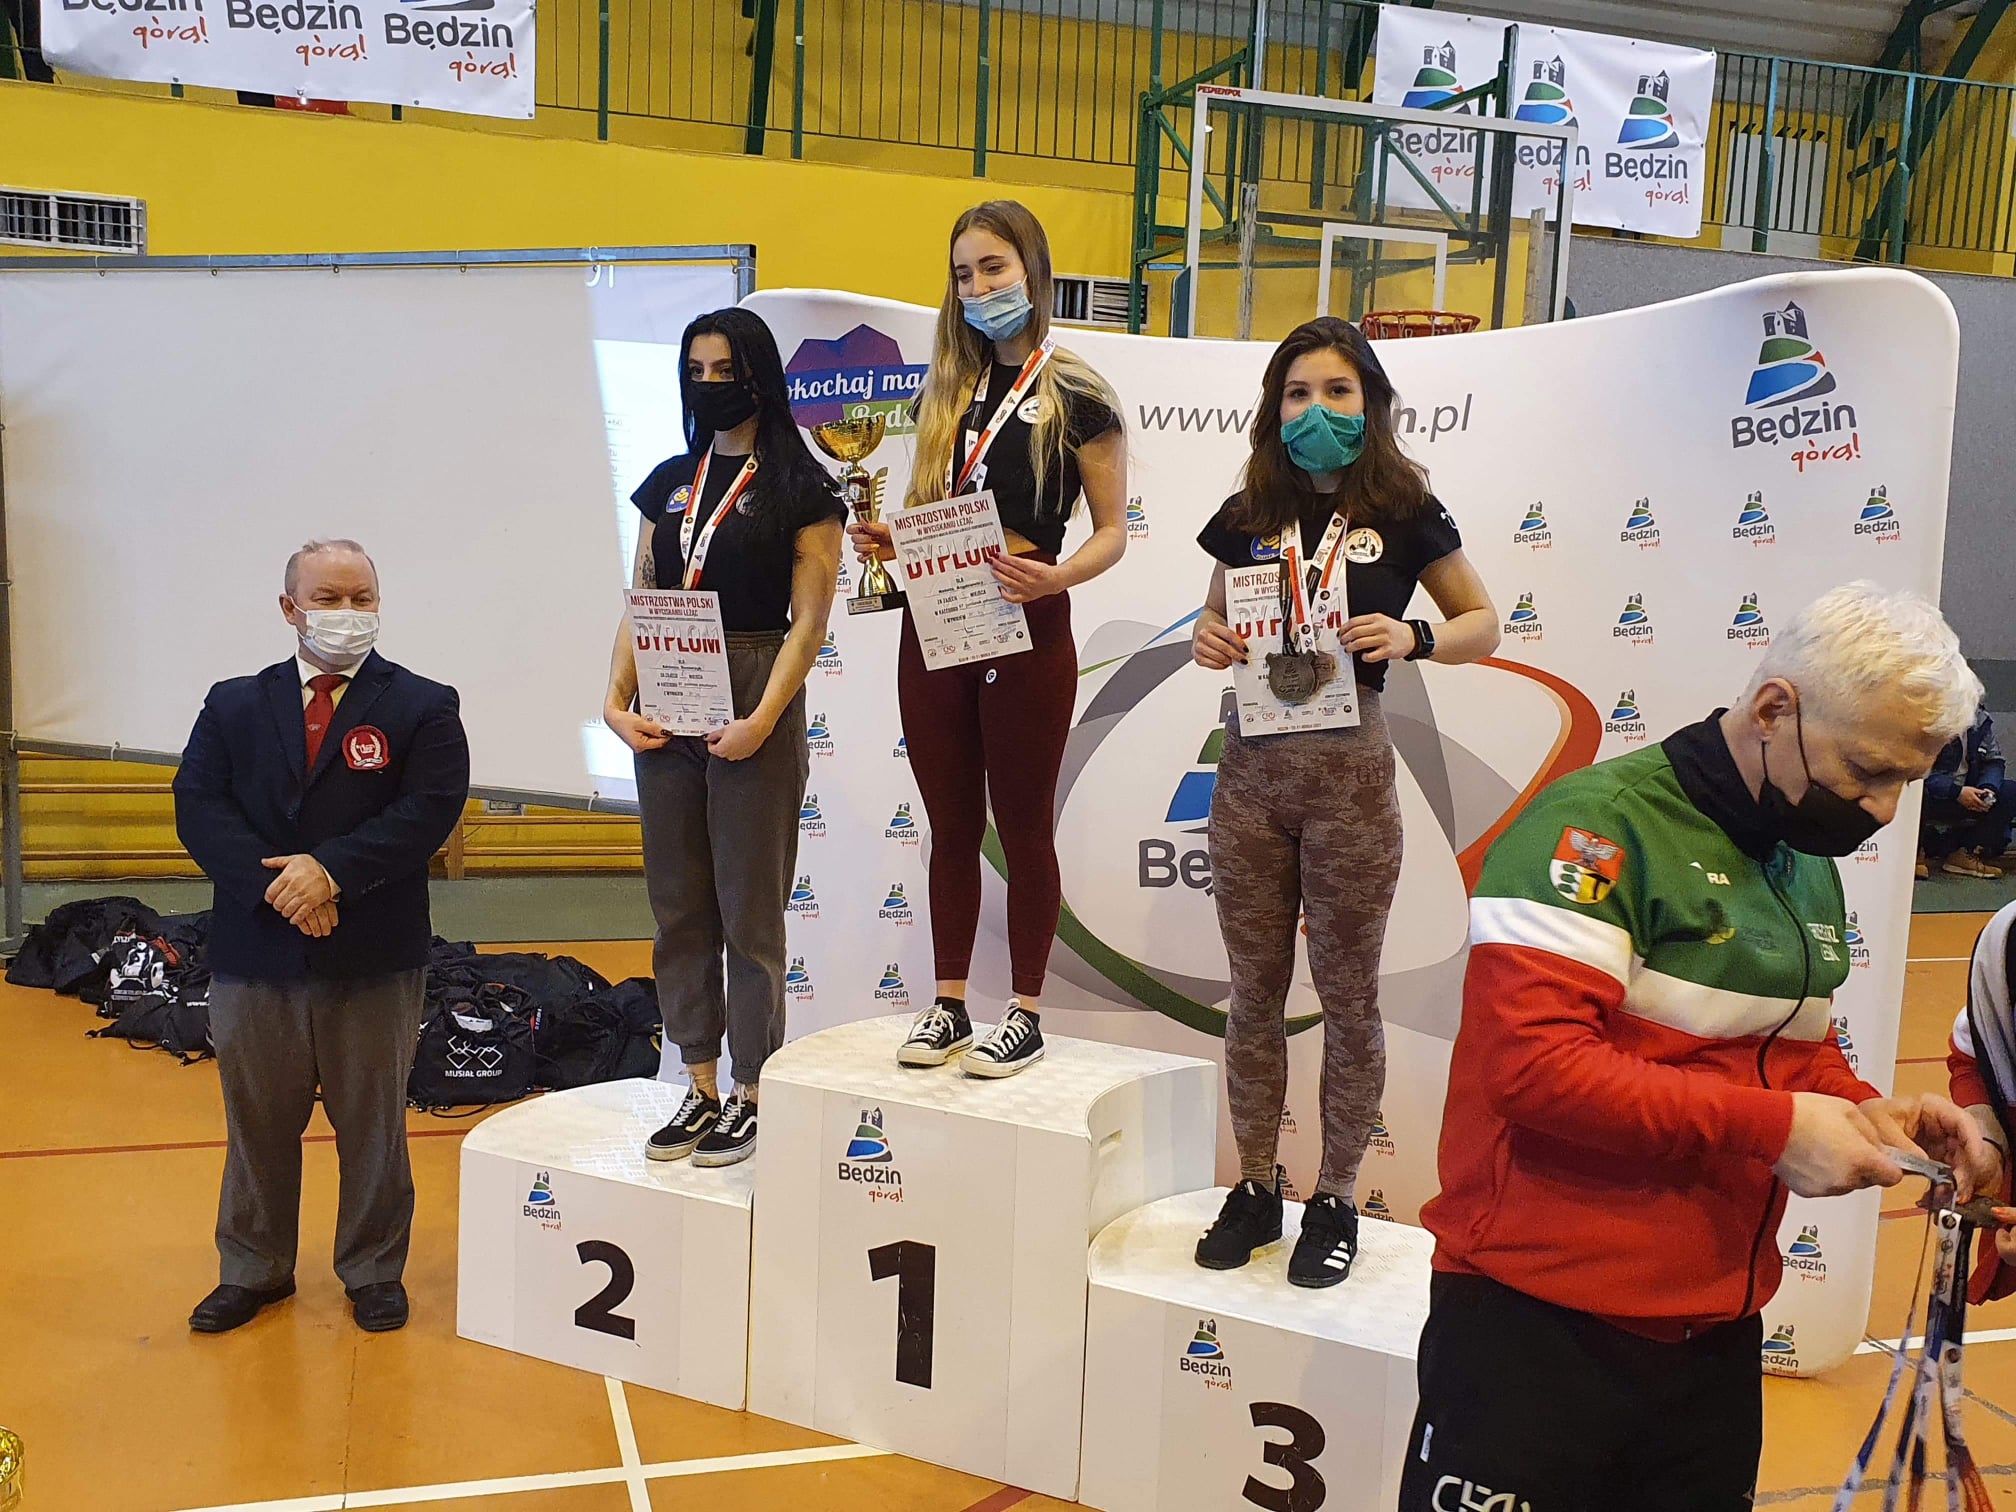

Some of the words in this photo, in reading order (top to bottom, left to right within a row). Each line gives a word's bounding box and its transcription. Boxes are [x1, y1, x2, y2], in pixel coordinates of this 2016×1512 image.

[227, 0, 363, 34] Będzin
[384, 13, 514, 50] Będzin
[1605, 152, 1688, 182] Będzin
[1731, 401, 1857, 448] Będzin
[894, 506, 958, 531] MISTRZOSTWA
[958, 499, 990, 516] POLSKI
[1854, 520, 1900, 535] Będzin
[1732, 524, 1775, 538] Będzin
[902, 529, 1002, 580] DYPLOM
[1233, 572, 1281, 588] MISTRZOS
[630, 595, 685, 608] MISTRZOSTWA
[687, 597, 714, 609] POLSKI
[635, 623, 721, 654] DYPLOM
[1727, 626, 1770, 641] Będzin
[476, 1069, 503, 1078] GROUP
[838, 1163, 903, 1184] Będzin
[523, 1205, 561, 1220] Będzin
[575, 1240, 635, 1341] 2
[868, 1240, 936, 1390] 1
[1180, 1357, 1232, 1377] Będzin
[1242, 1402, 1326, 1512] 3
